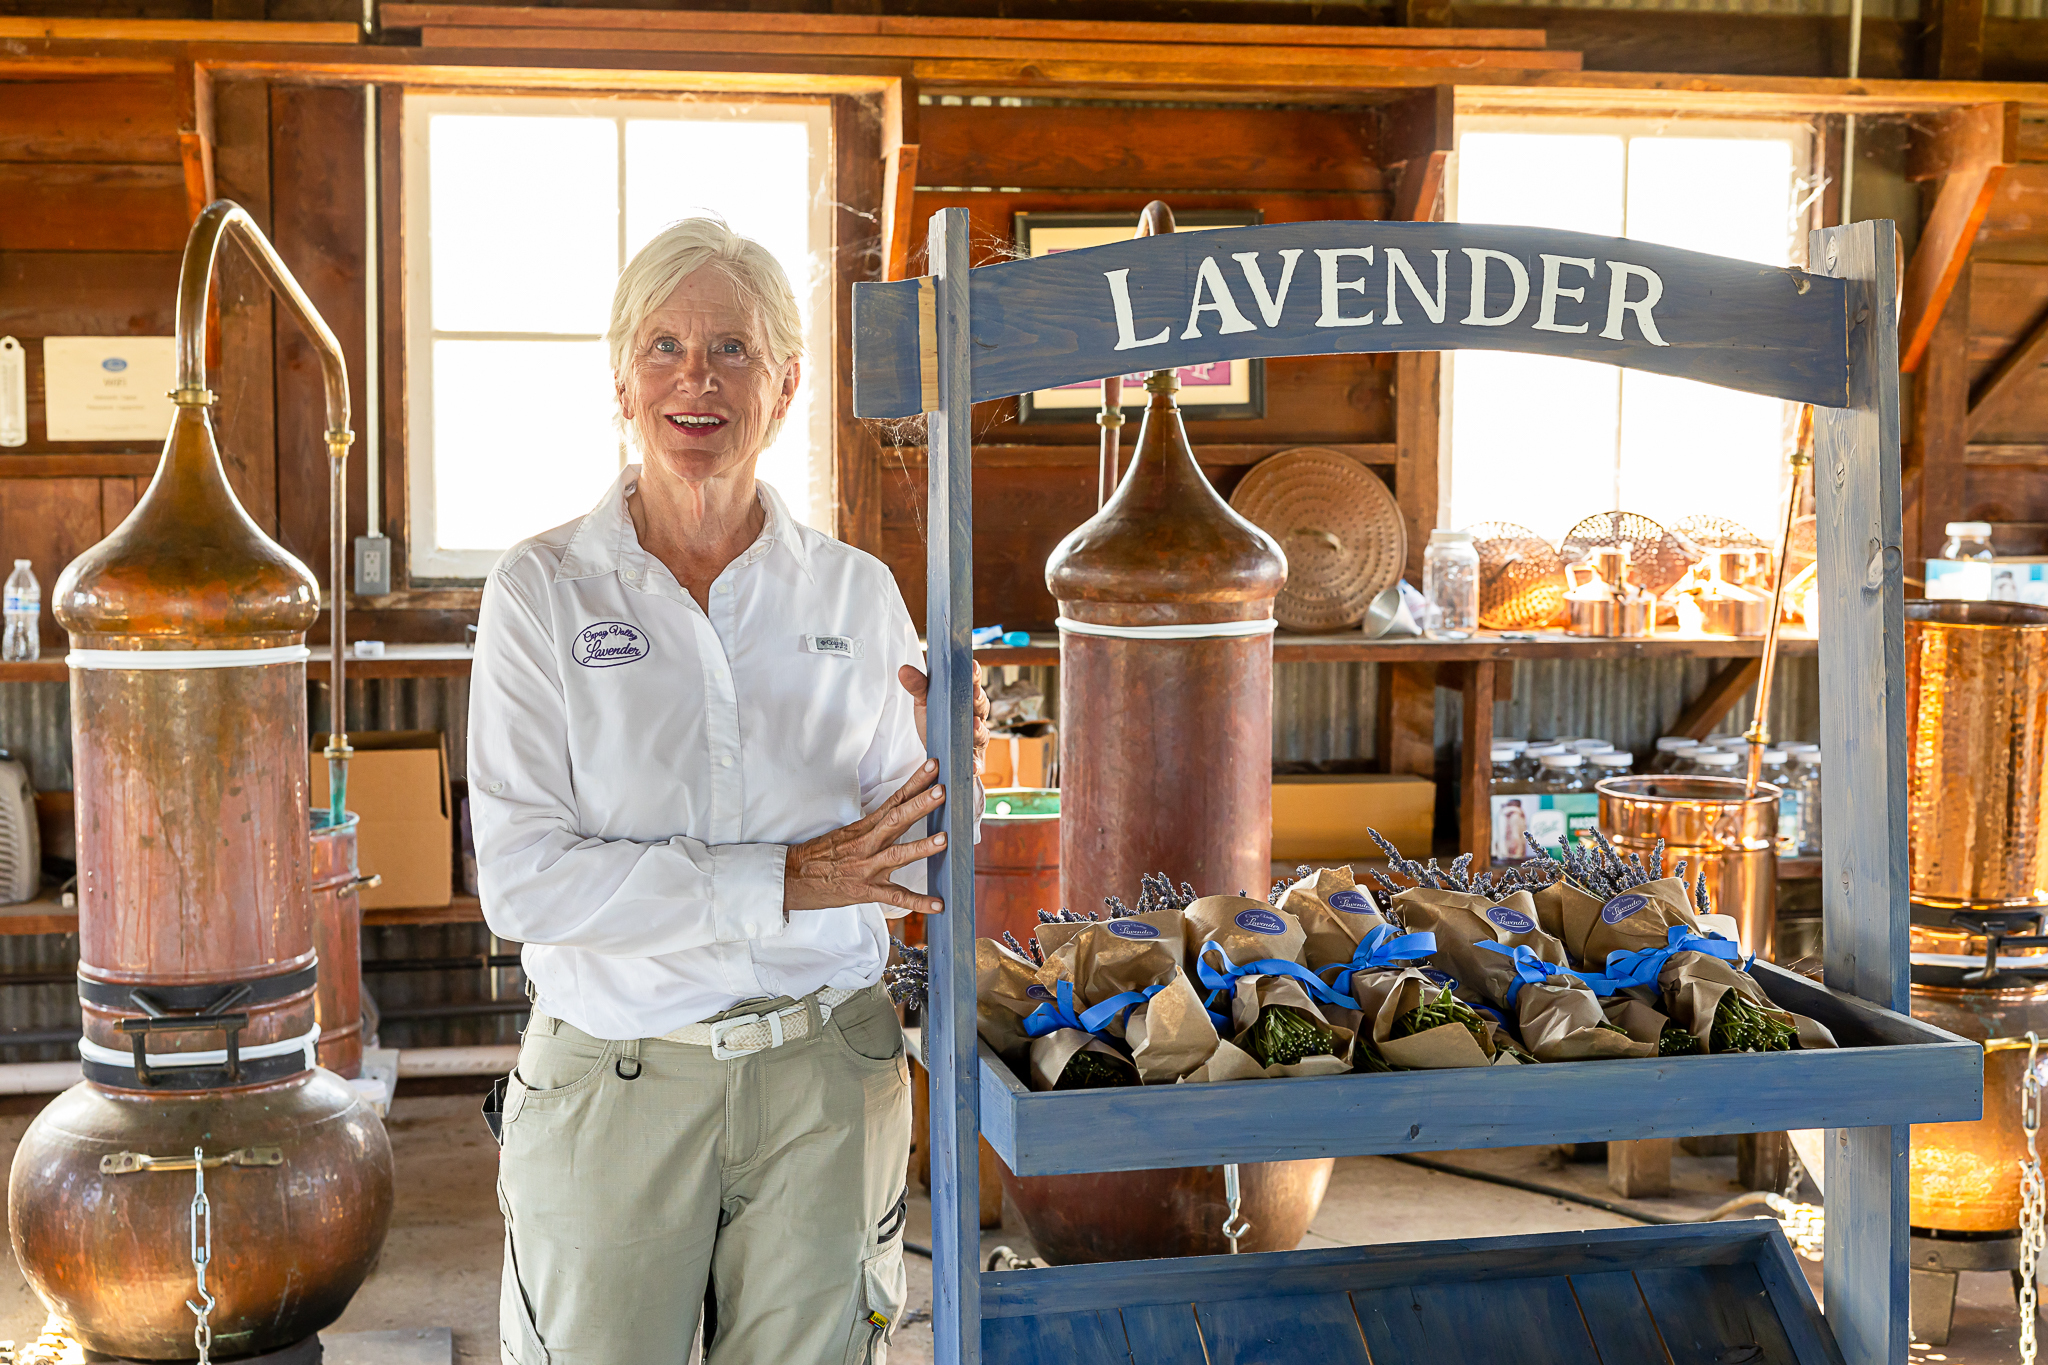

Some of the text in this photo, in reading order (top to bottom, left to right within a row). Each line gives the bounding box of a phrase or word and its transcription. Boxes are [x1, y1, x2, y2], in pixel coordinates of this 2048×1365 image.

[1103, 246, 1671, 350] LAVENDER
[583, 624, 638, 643] Capay Valley
[582, 639, 642, 664] Lavender
